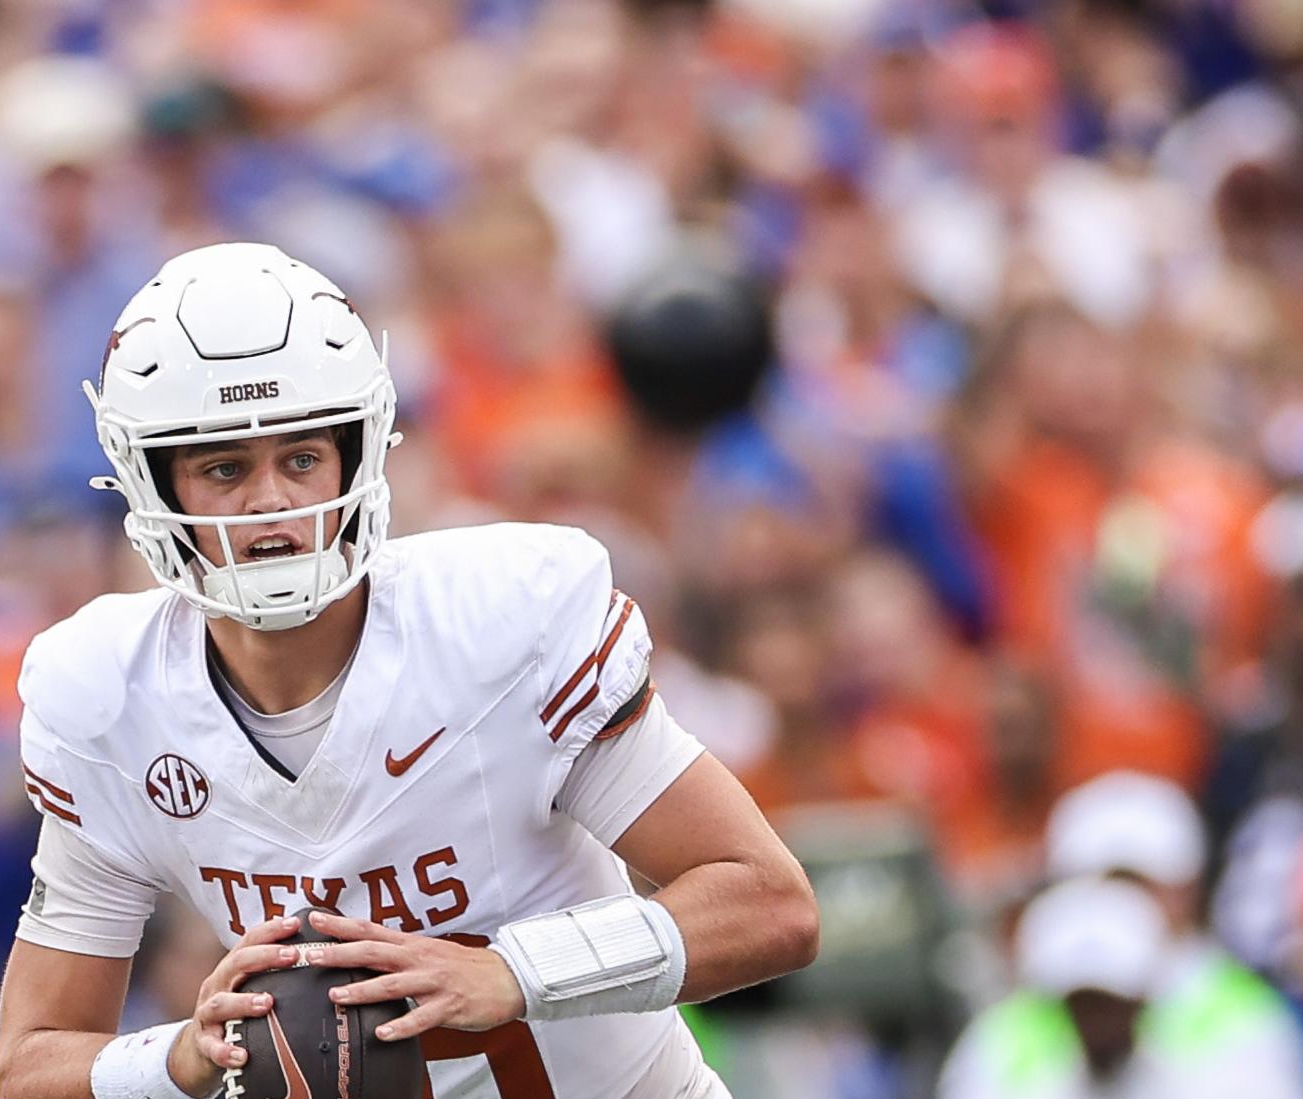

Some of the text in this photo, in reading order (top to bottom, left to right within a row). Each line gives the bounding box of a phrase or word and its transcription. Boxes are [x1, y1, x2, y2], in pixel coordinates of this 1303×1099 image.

[219, 381, 280, 404] HORNS
[148, 756, 207, 816] SEC
[199, 846, 469, 937] TEXAS
[334, 1003, 349, 1041] ELIT
